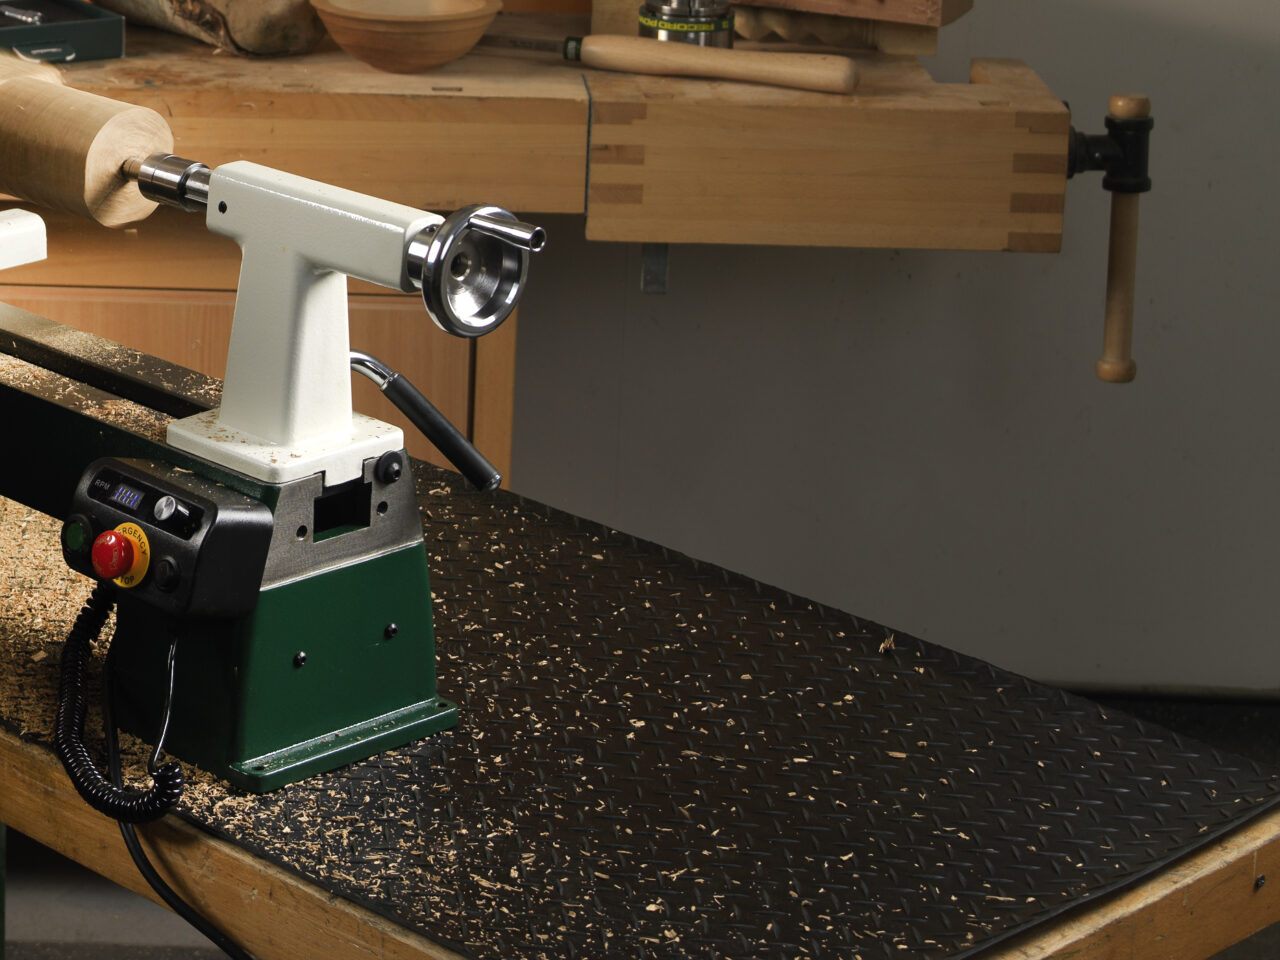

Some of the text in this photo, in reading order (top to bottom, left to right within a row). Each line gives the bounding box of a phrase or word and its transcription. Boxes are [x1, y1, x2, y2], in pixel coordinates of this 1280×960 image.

[658, 20, 714, 31] RECORD
[94, 479, 111, 491] RPM
[118, 526, 148, 556] RGENCY
